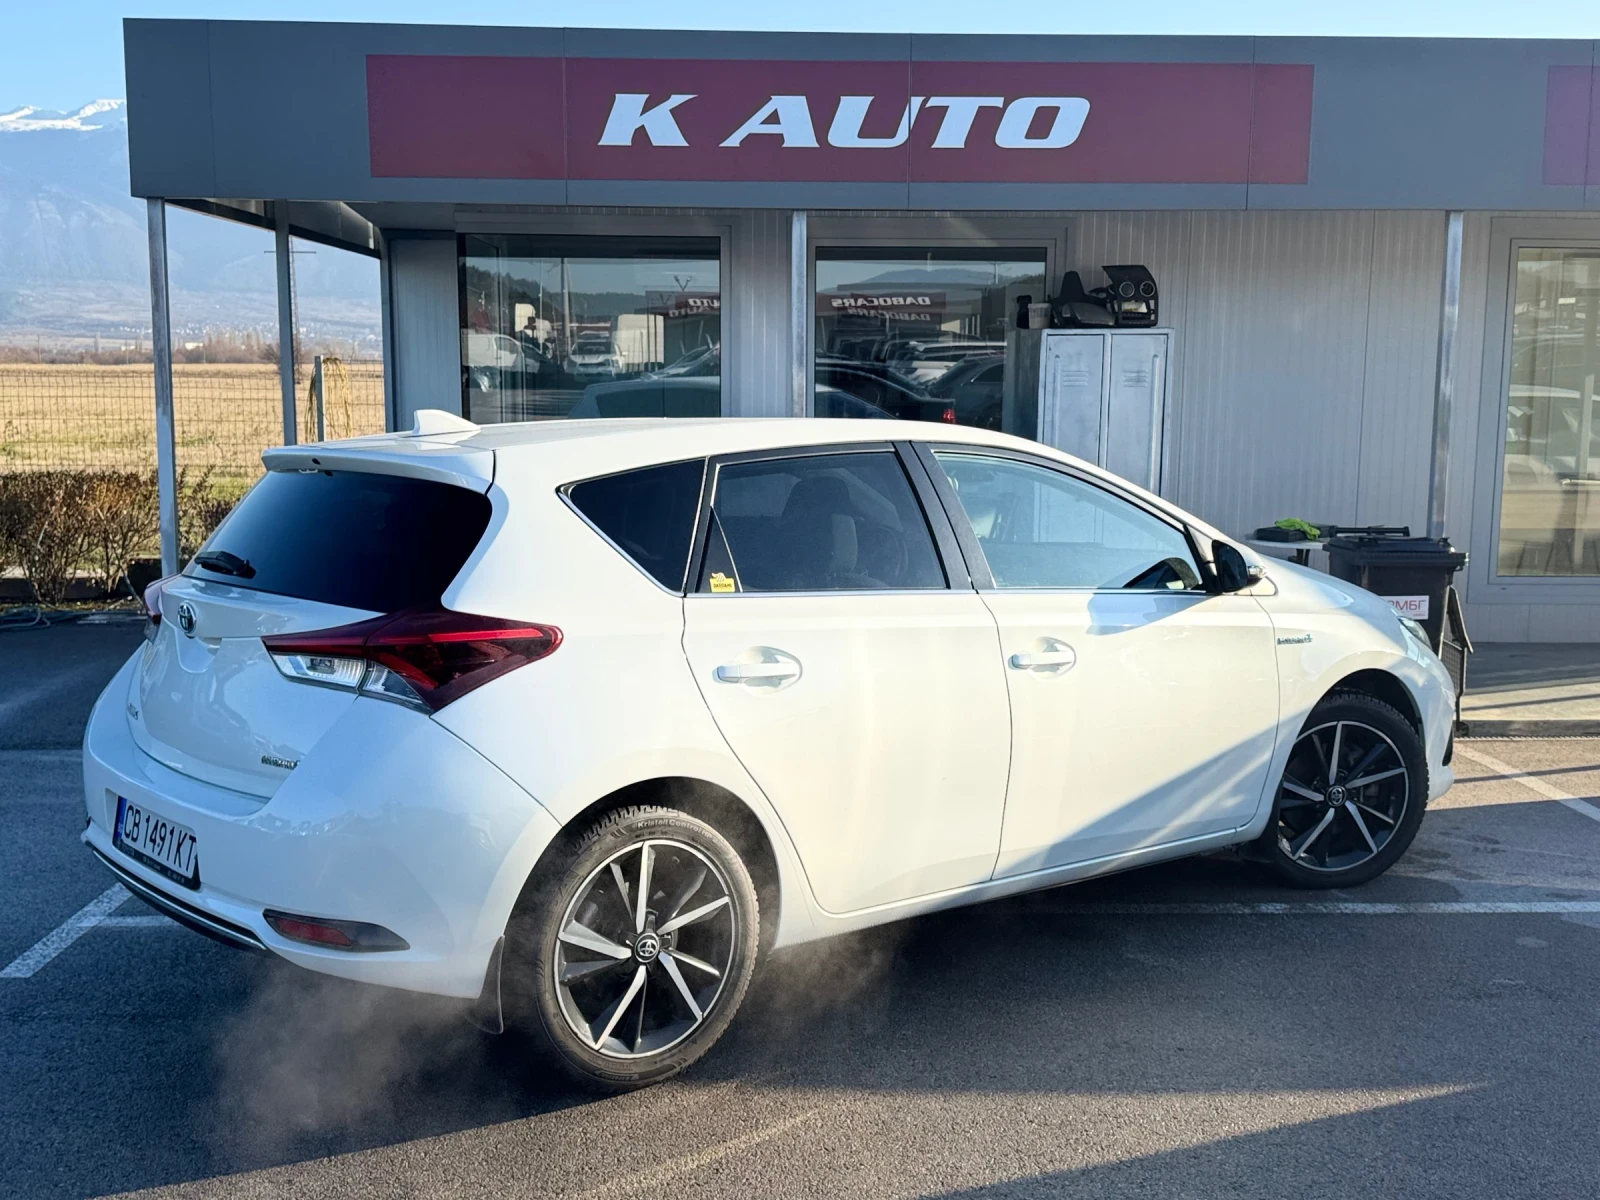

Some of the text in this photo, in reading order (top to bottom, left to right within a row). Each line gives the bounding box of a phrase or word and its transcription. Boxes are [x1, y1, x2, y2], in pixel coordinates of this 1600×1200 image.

[597, 93, 1091, 149] K AUTO
[124, 804, 142, 842] CB
